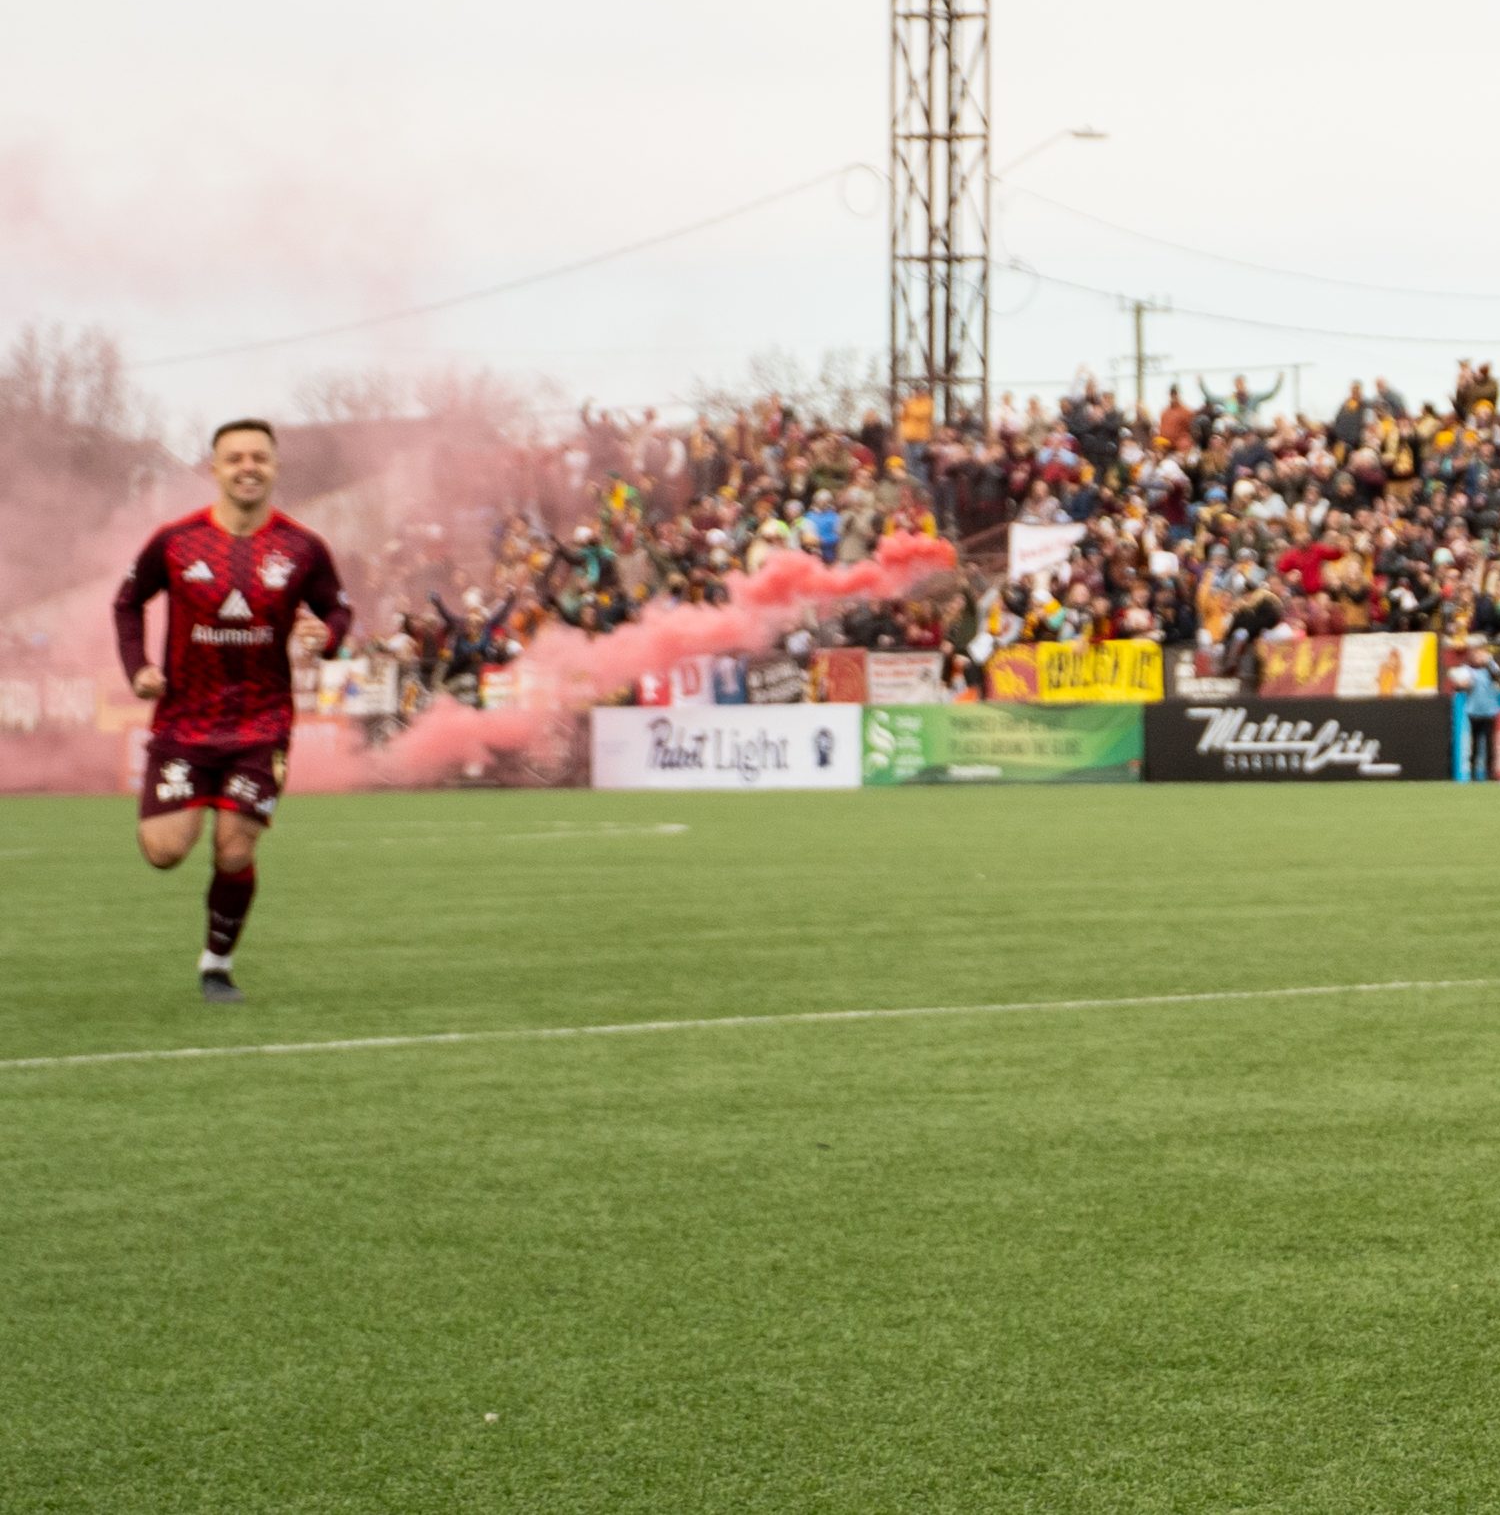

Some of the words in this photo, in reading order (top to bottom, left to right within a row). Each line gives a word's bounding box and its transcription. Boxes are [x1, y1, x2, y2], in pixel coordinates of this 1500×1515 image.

[713, 728, 790, 782] Light
[1186, 707, 1313, 754] Motor
[1302, 719, 1402, 773] City
